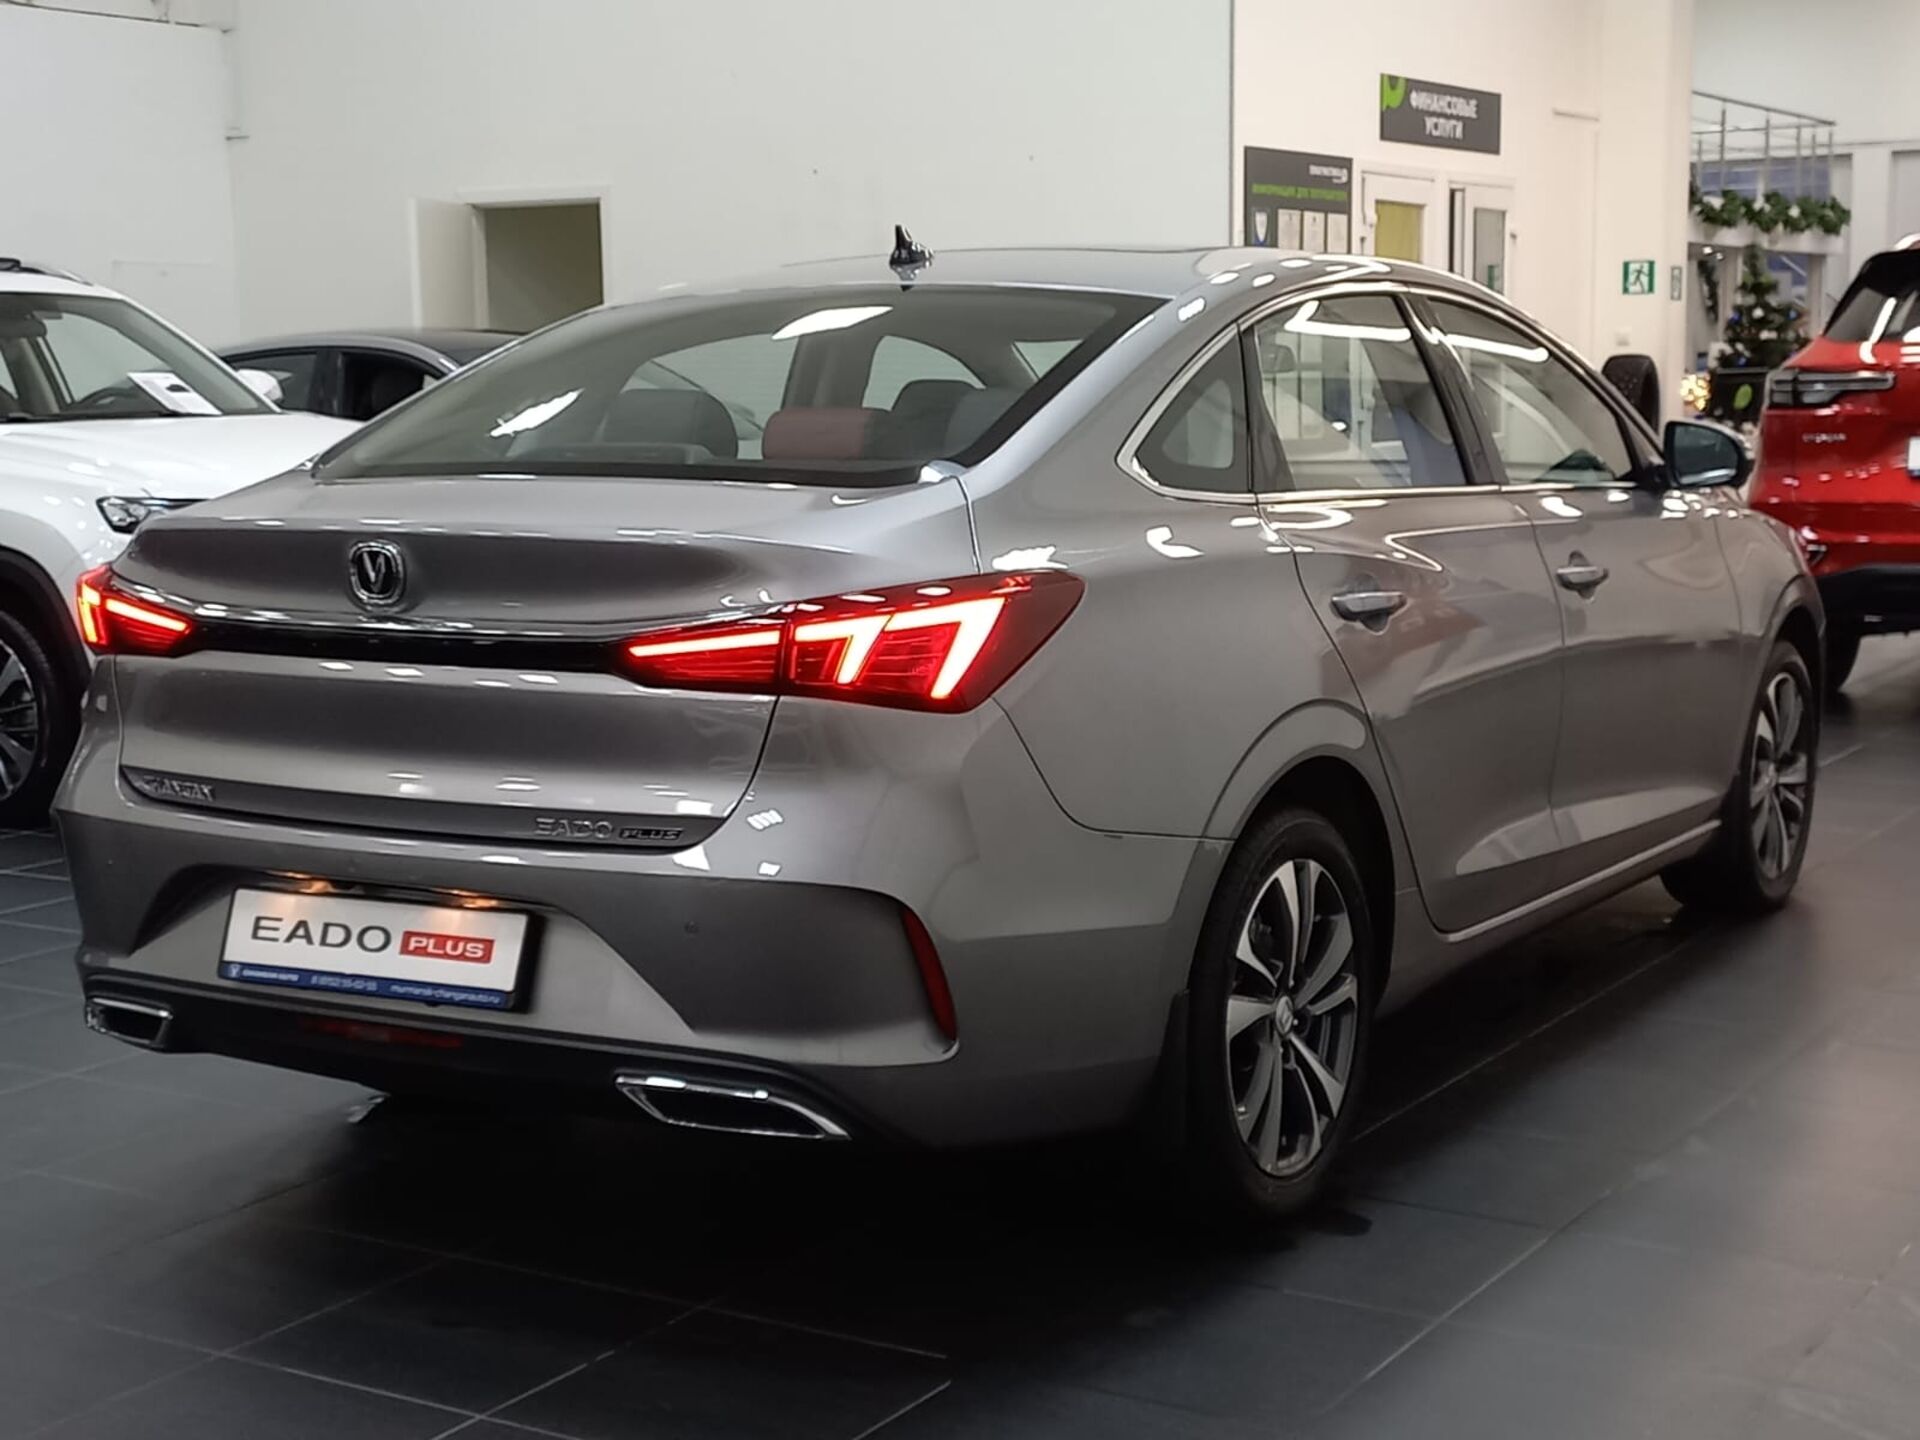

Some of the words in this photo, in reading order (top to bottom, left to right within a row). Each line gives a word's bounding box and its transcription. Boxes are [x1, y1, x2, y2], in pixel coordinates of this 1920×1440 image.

[534, 817, 613, 839] EADO
[250, 915, 392, 953] EADO
[407, 935, 485, 959] PLUS
